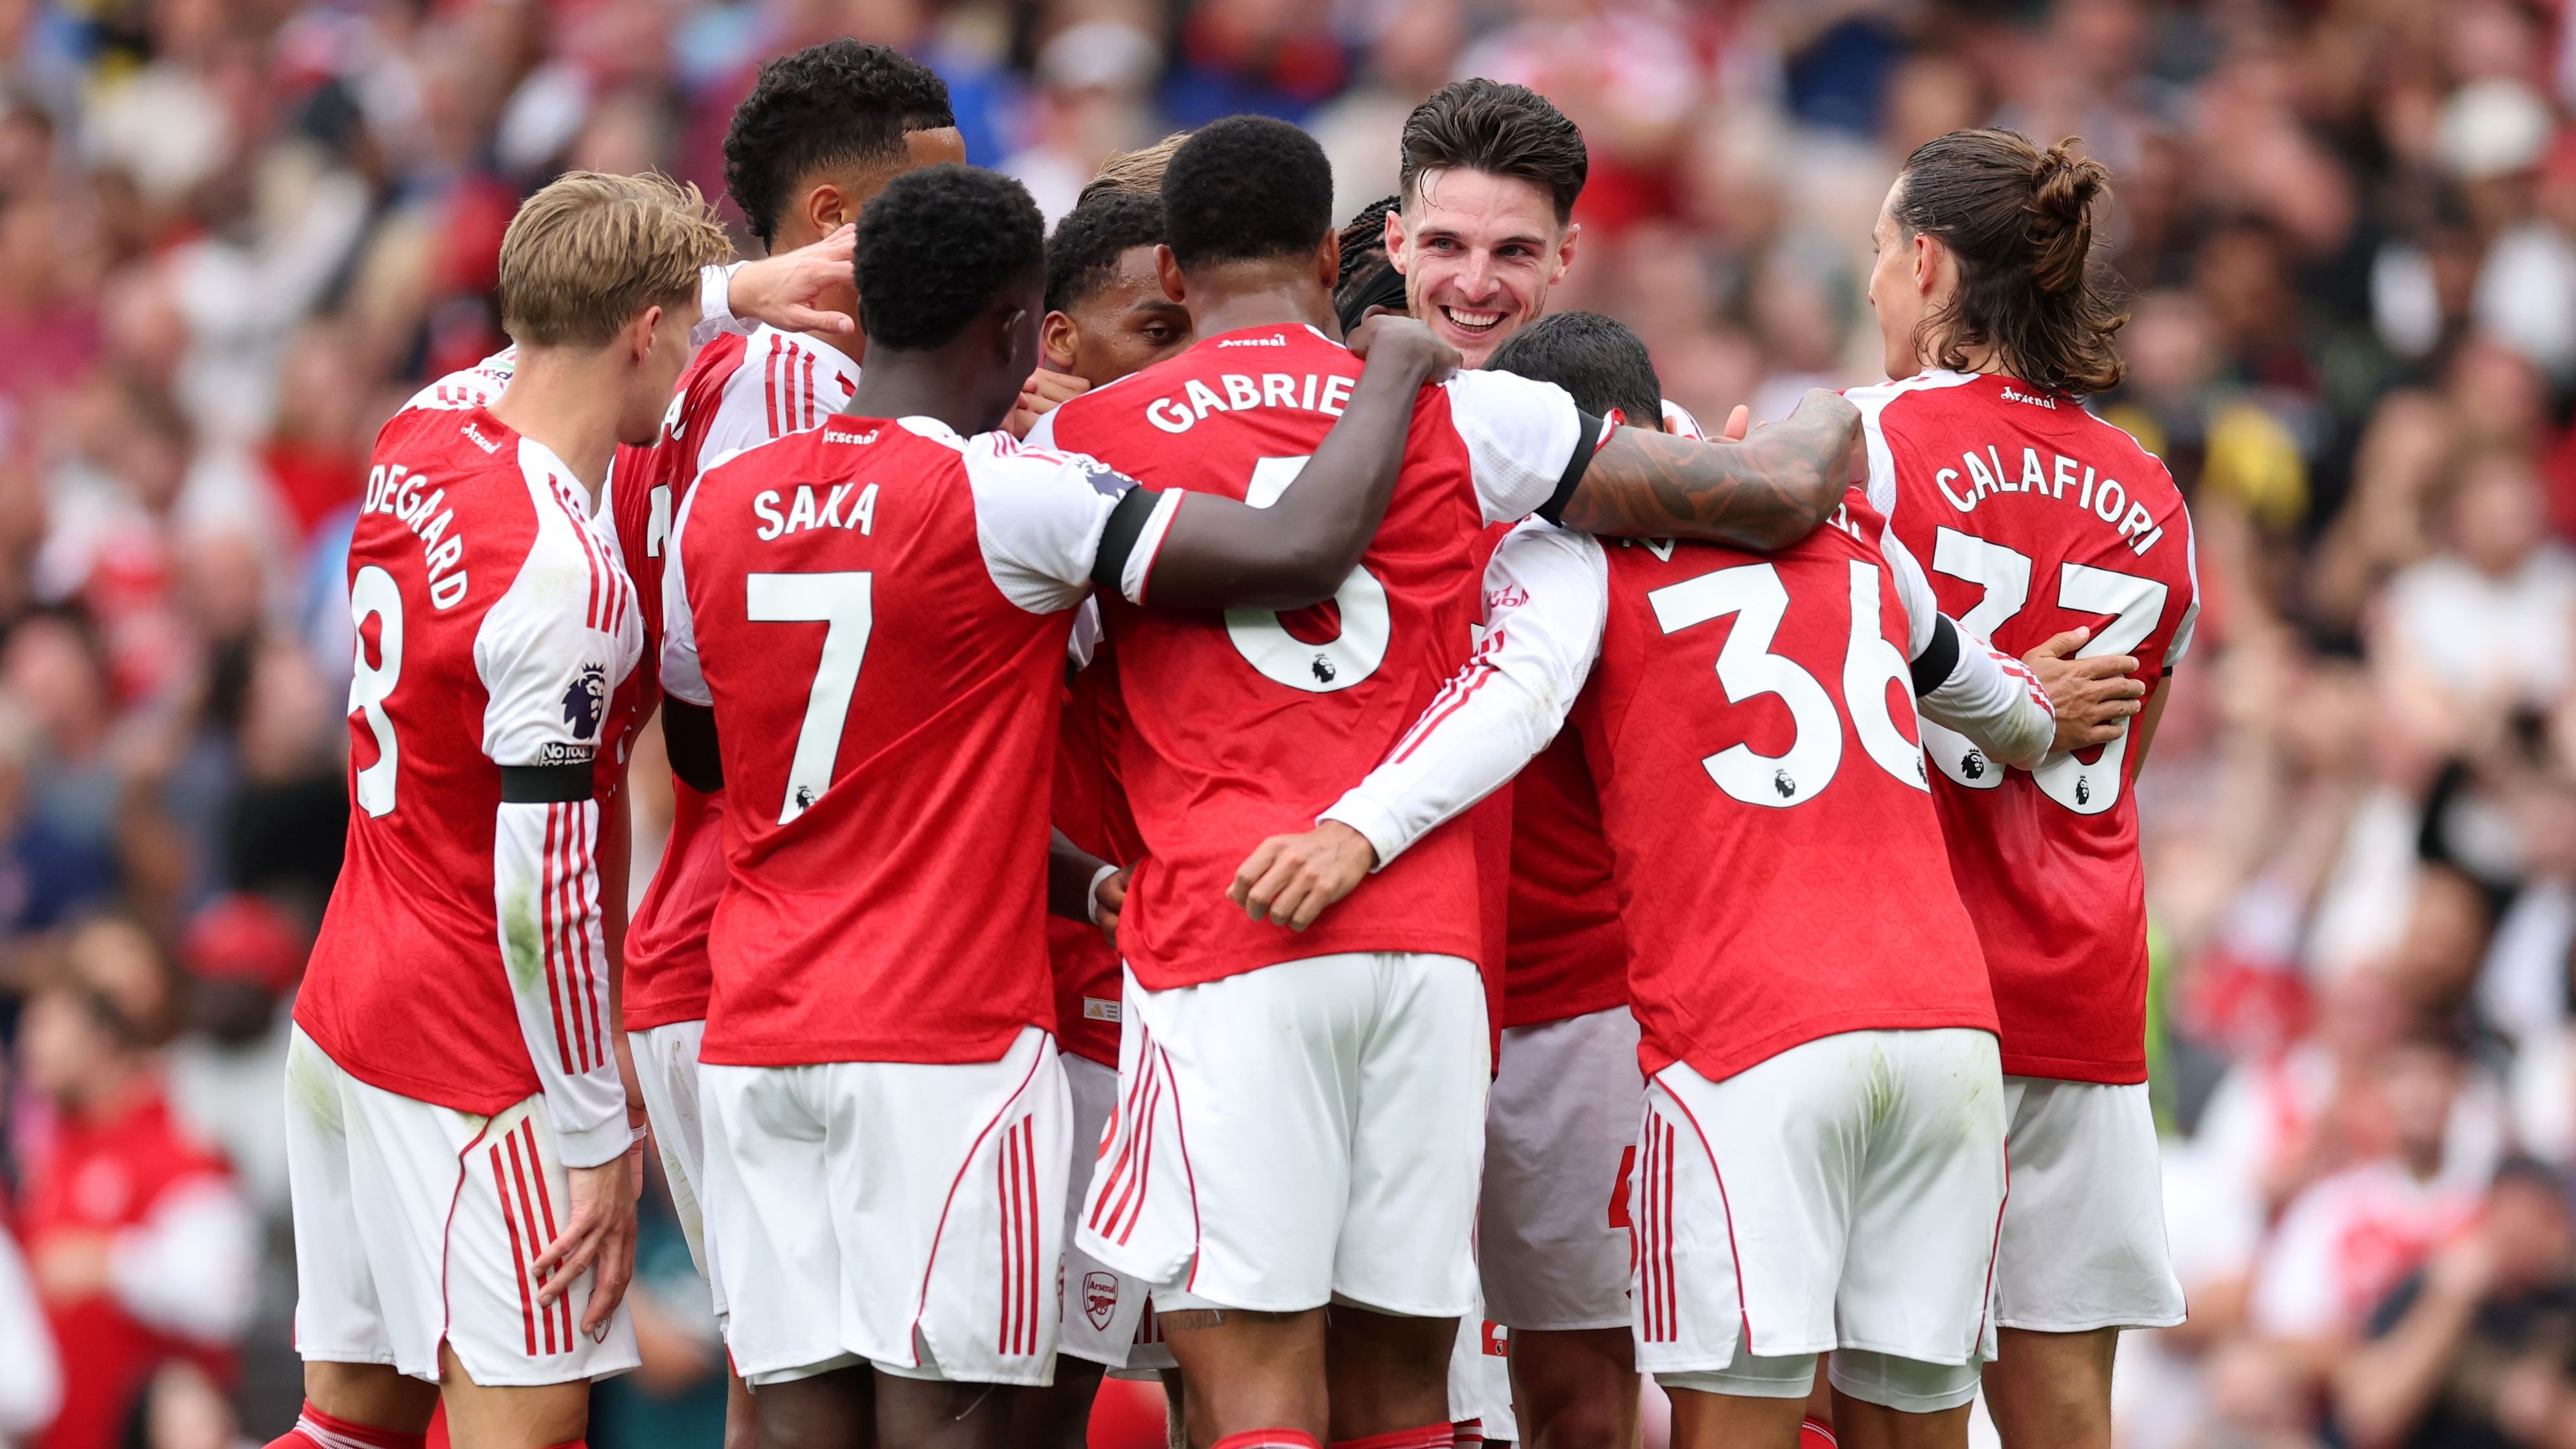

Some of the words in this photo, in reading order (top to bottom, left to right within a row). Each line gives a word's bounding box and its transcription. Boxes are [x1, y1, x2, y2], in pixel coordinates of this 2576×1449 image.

[1217, 333, 1286, 348] Arsenal
[1146, 372, 1356, 434] GABRIE
[2000, 386, 2057, 410] Arsenal
[461, 422, 503, 455] Arsenal
[821, 427, 880, 446] Arsenal
[753, 483, 880, 542] SAKA
[1936, 444, 2163, 557] CALAFIORI
[361, 462, 468, 611] DEGAARD
[347, 564, 404, 819] 8
[746, 570, 874, 827] 7
[1646, 561, 1931, 809] 36
[540, 743, 565, 759] No
[1088, 1281, 1115, 1294] Arsenal
